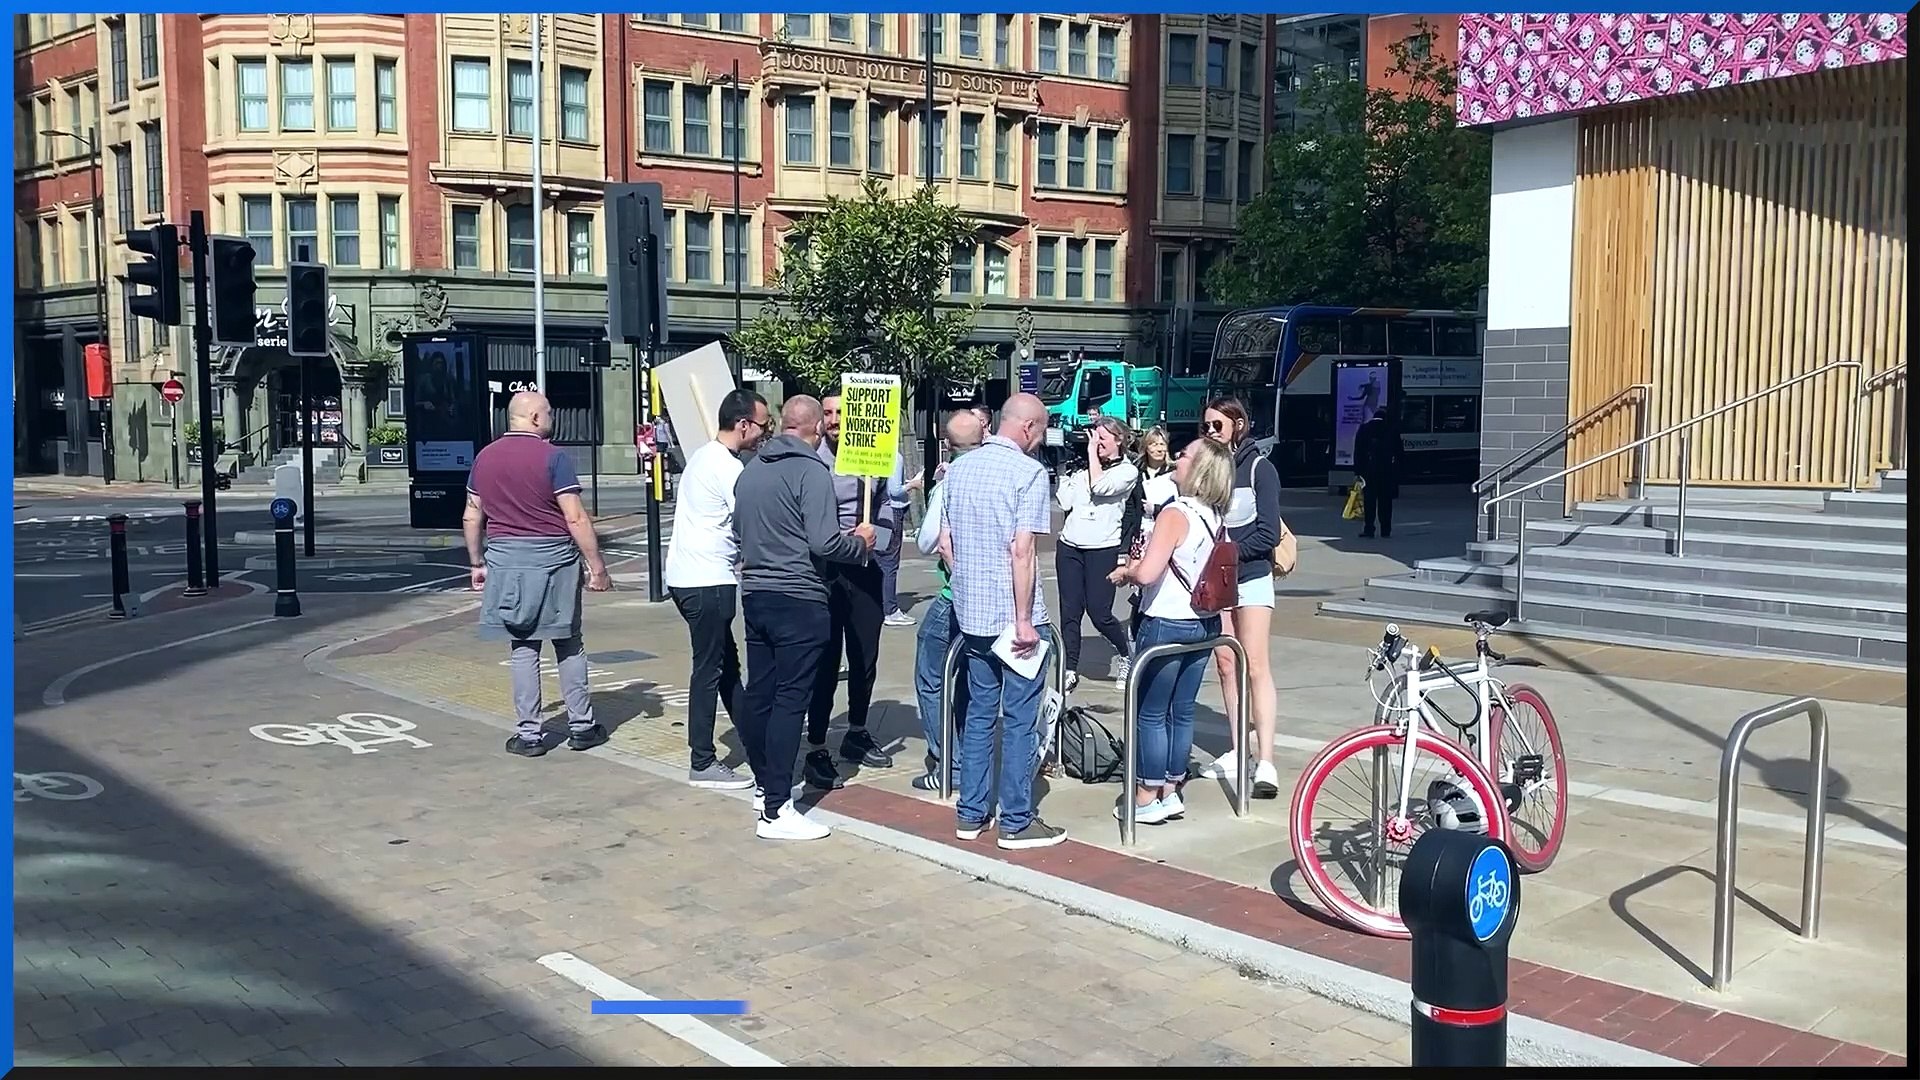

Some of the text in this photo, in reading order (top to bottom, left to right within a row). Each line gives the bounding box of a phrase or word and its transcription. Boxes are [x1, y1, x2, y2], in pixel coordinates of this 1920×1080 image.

[781, 53, 848, 75] JOSHUA
[856, 61, 910, 83] HOYLE
[918, 69, 952, 87] AND
[961, 74, 1003, 93] SONS
[257, 336, 288, 347] serie
[849, 376, 894, 385] Socialist Worker
[846, 387, 892, 403] SUPPORT
[846, 402, 887, 419] THE RAIL
[845, 417, 895, 434] WORKERS'
[844, 432, 876, 448] STRIKE
[1404, 439, 1438, 449] tagecoach
